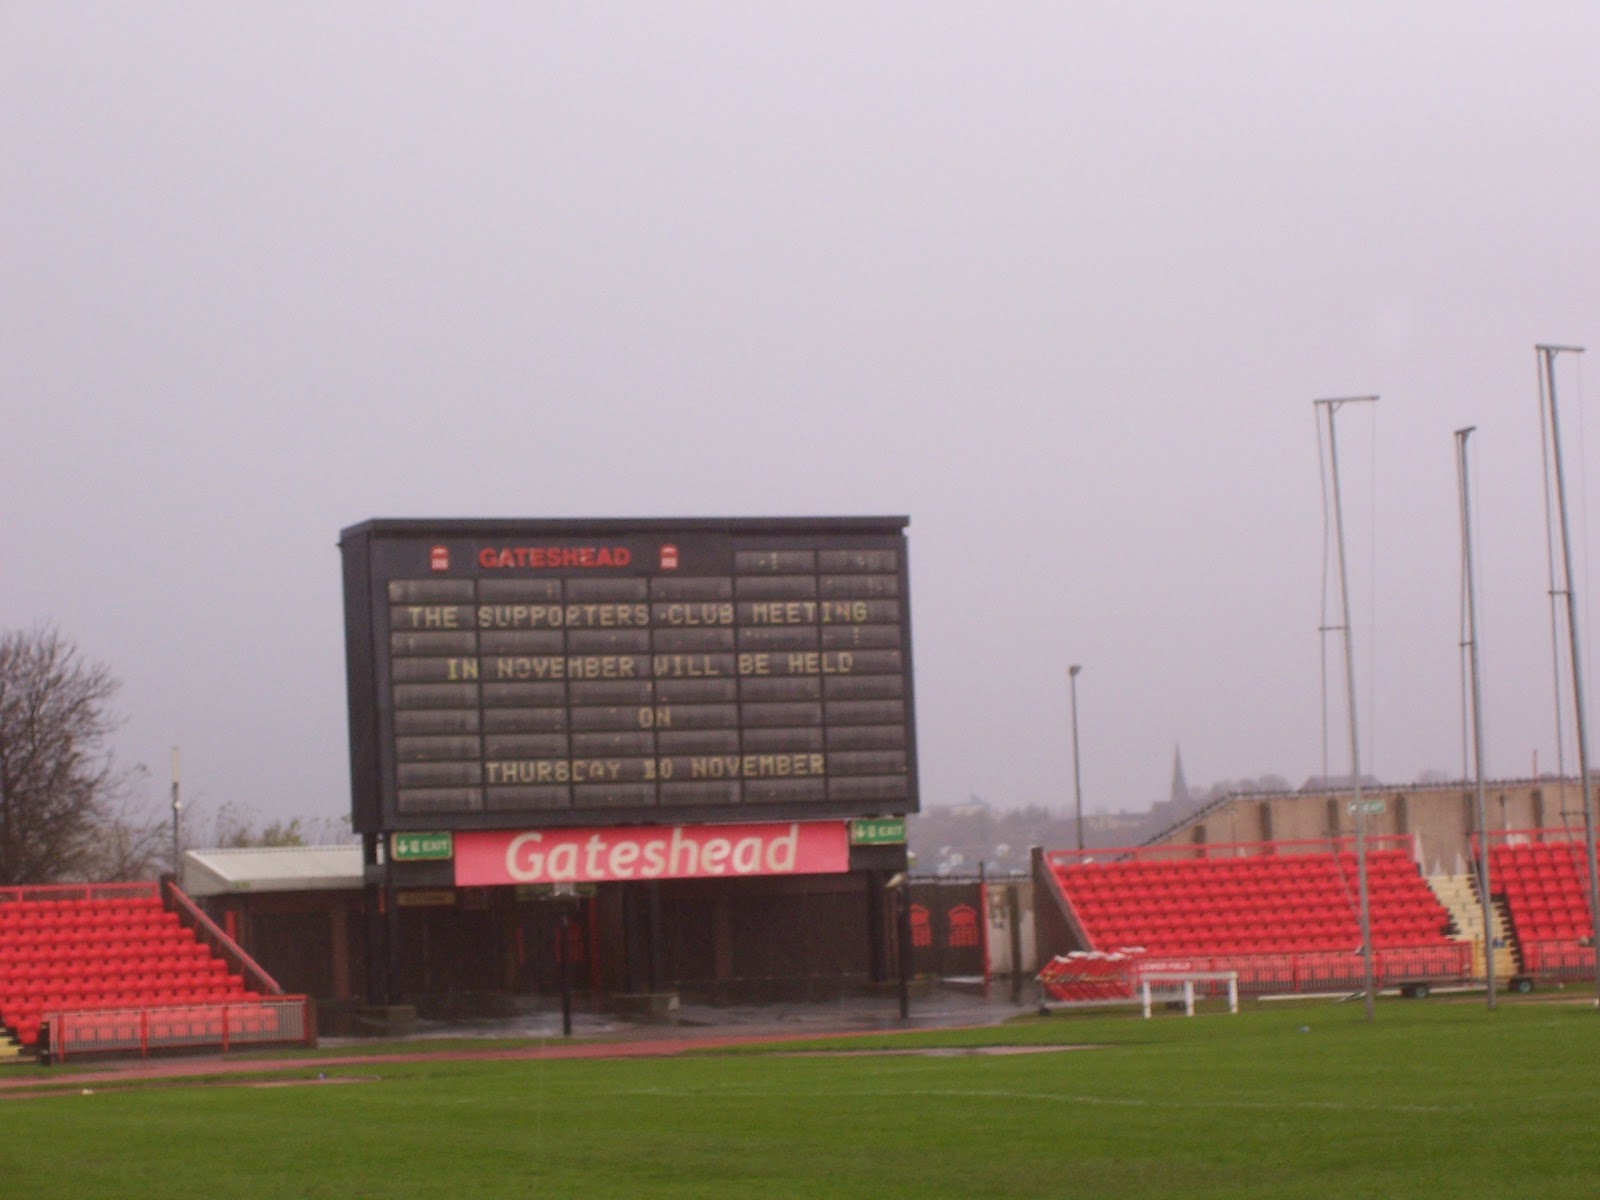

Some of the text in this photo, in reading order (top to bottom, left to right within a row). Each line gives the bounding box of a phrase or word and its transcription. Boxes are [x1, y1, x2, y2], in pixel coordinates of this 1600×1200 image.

[478, 546, 632, 568] GATESHEAD
[408, 601, 868, 628] THE SUPPORTERS CLUB MEETING
[447, 652, 854, 680] IN NOVEMBER WILL BE HELD
[638, 706, 671, 728] ON
[690, 753, 825, 778] NOVEMBER
[421, 840, 449, 852] EXIT
[505, 823, 799, 881] Gateshead
